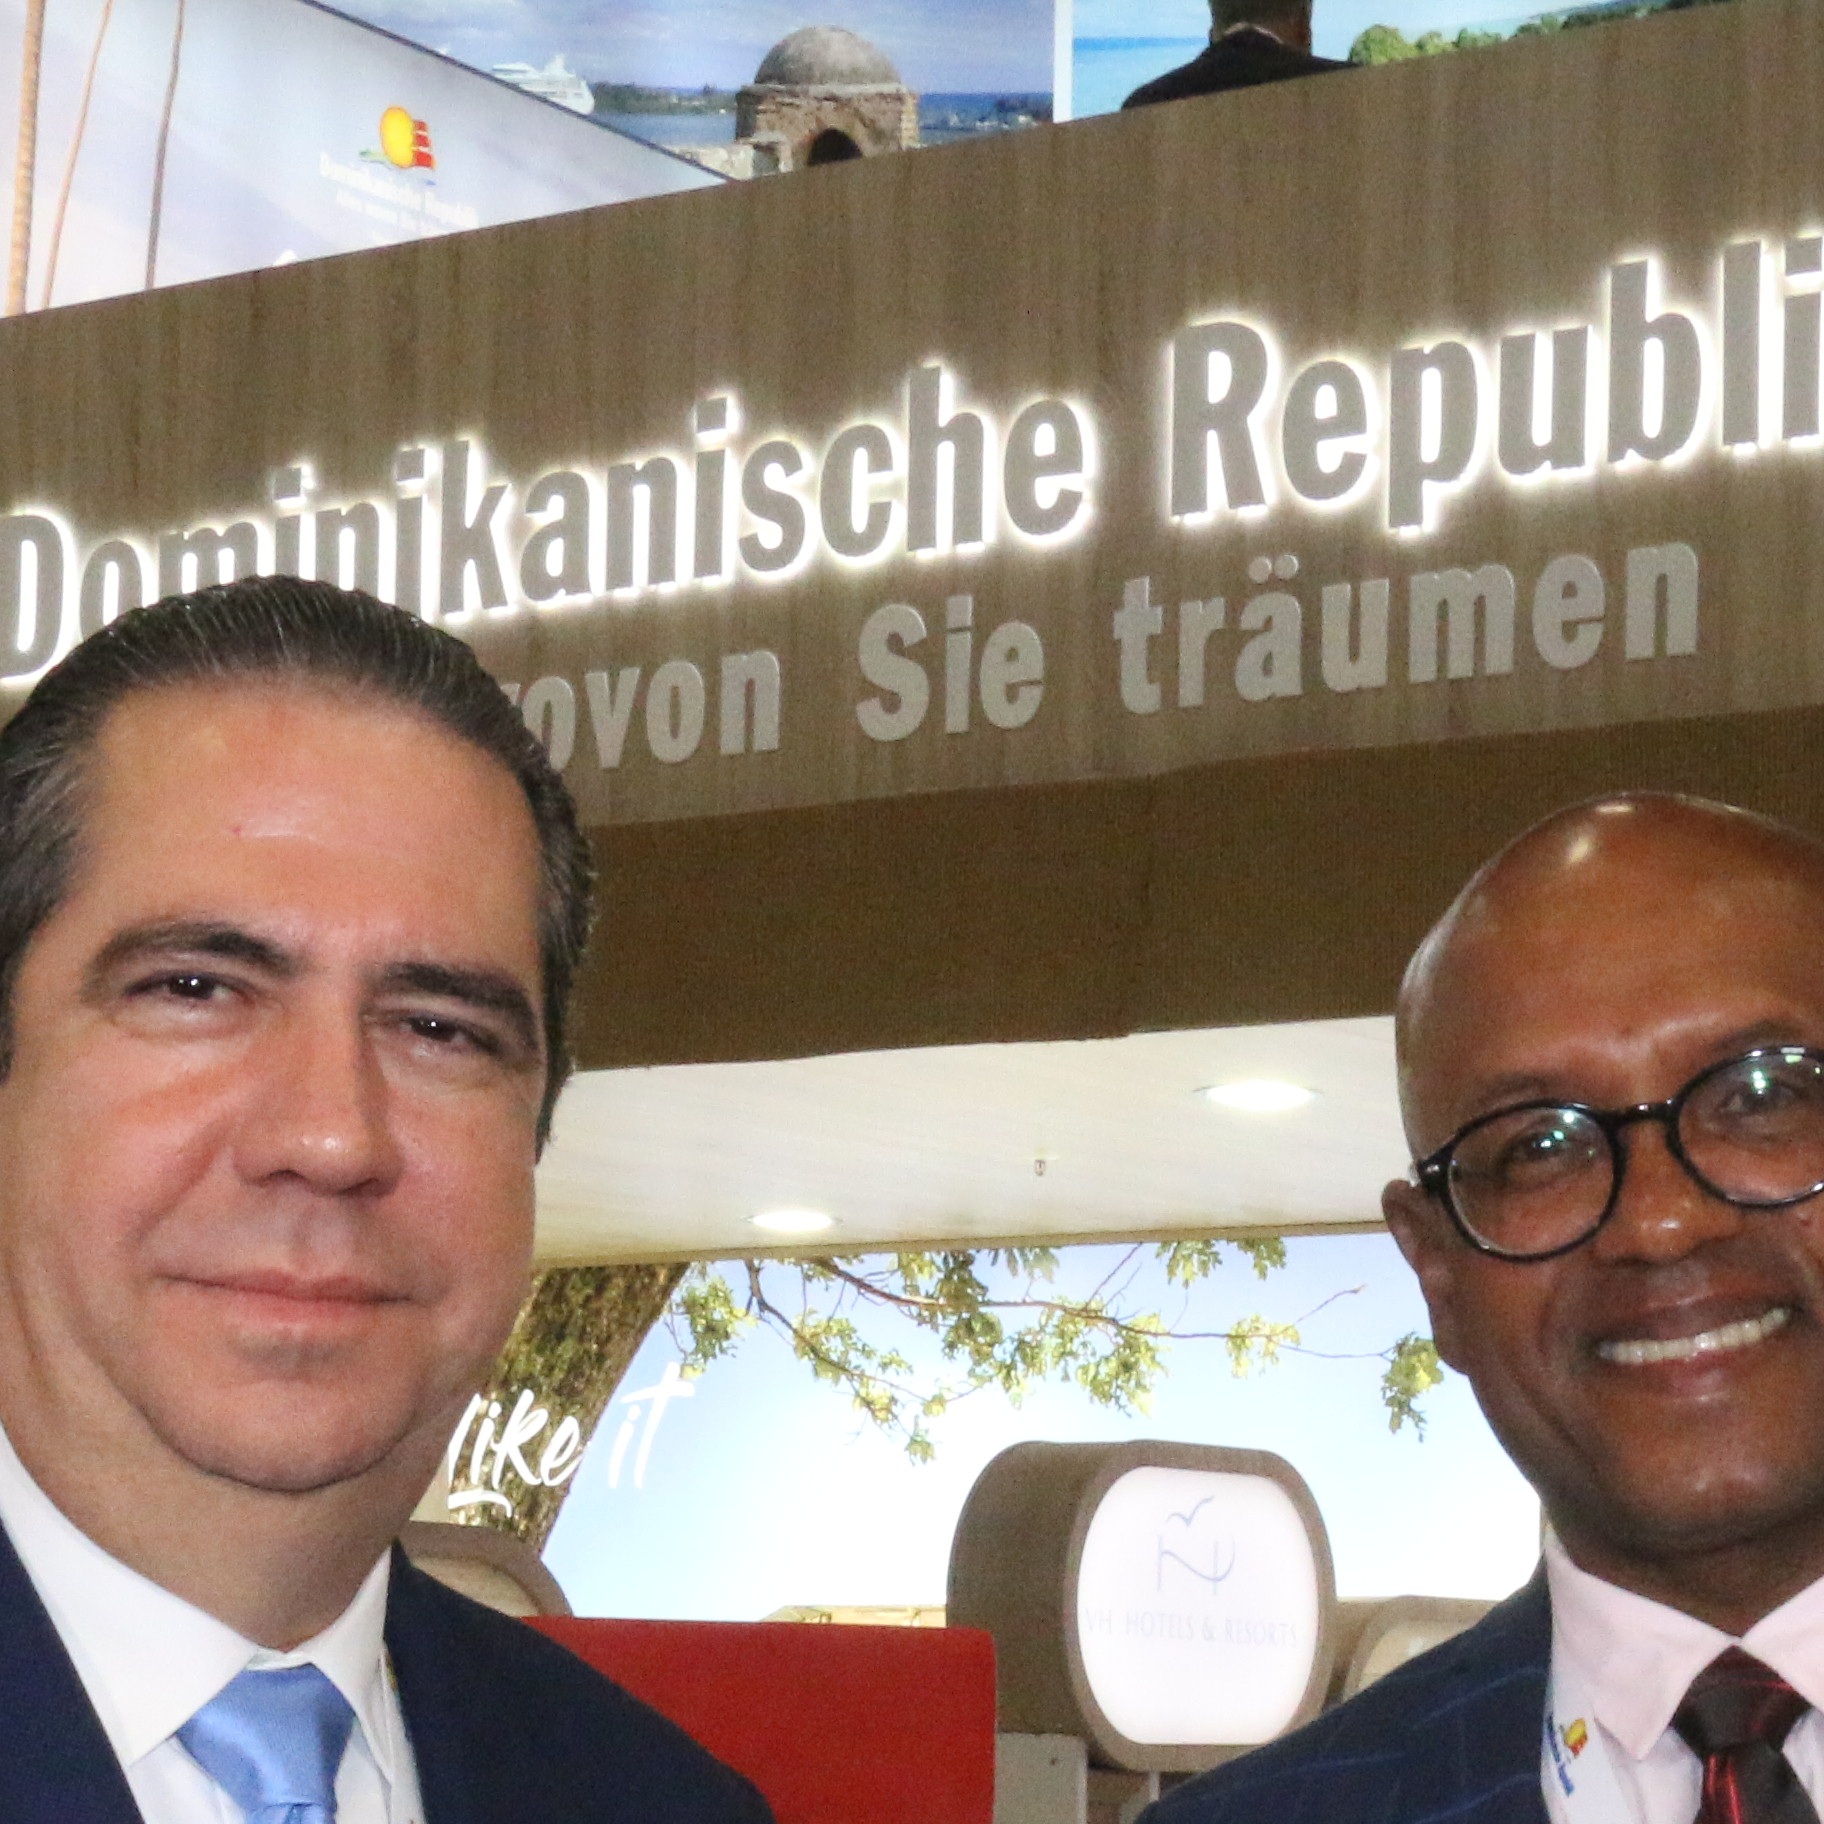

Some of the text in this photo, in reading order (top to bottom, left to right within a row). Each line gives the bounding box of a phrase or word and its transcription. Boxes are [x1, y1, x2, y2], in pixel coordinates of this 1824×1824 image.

[501, 540, 1699, 771] ovon Sie träumen
[1124, 1610, 1195, 1641] HOTELS
[1201, 1616, 1217, 1642] &
[1224, 1617, 1297, 1648] RESORTS
